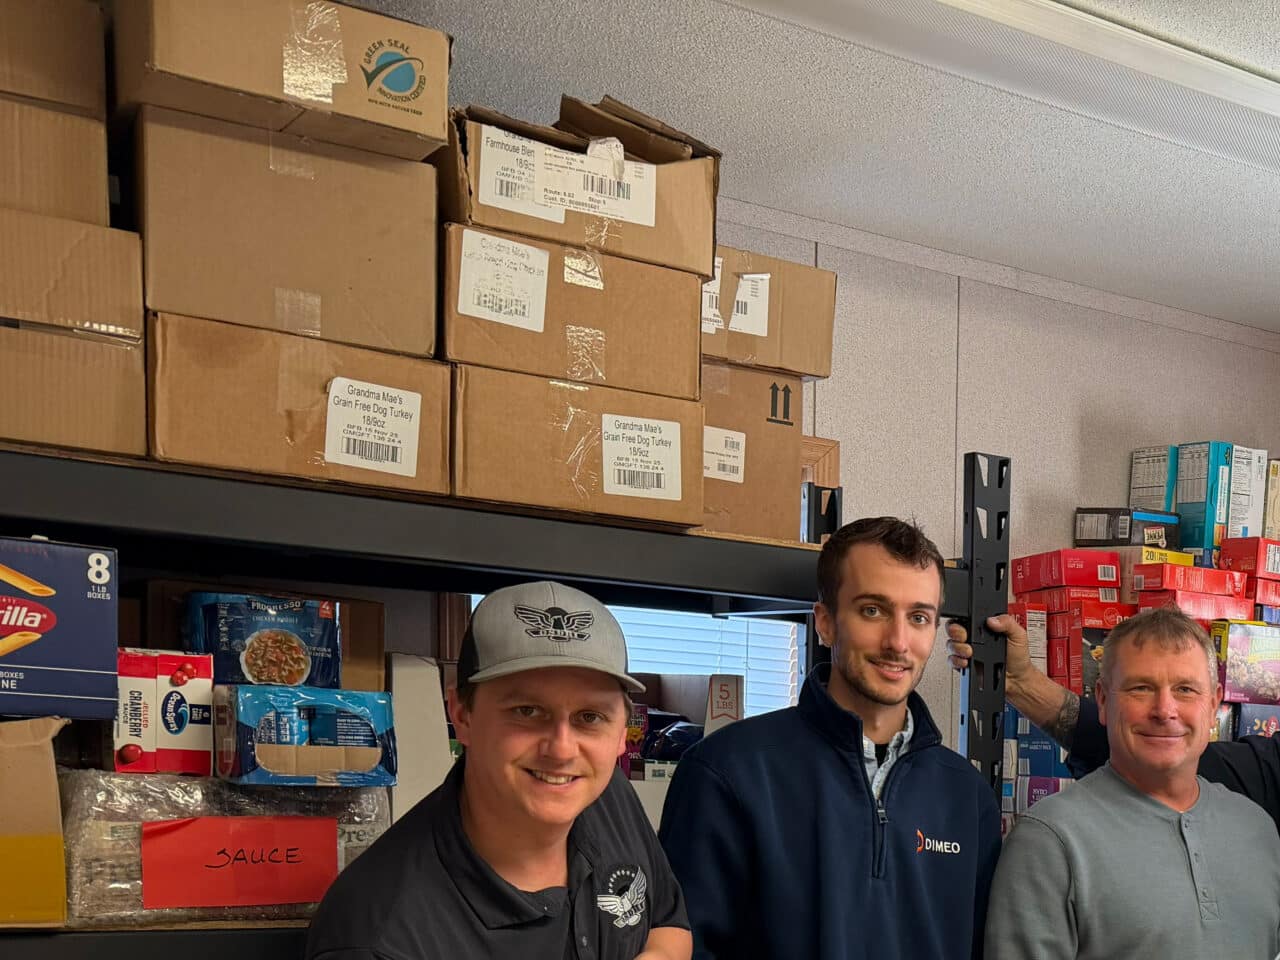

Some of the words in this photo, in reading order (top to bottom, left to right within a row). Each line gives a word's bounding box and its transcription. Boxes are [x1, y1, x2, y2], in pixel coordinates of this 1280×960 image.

[363, 40, 385, 64] GREEN
[387, 38, 411, 55] SEAL
[486, 136, 520, 155] Farmhouse
[521, 146, 535, 158] Blen
[347, 384, 380, 400] Grandma
[382, 391, 403, 405] Mae's
[333, 395, 353, 409] Grain
[354, 399, 372, 412] Free
[372, 403, 388, 418] Dog
[389, 406, 414, 422] Turkey
[362, 415, 386, 428] 18/9oz
[614, 419, 643, 432] Grandma
[644, 423, 662, 434] Mae's
[603, 431, 620, 441] Grain
[621, 433, 636, 444] Free
[637, 434, 650, 447] Dog
[651, 436, 672, 449] Turkey
[629, 446, 649, 458] 18/9oz
[87, 553, 111, 585] 8
[87, 591, 111, 600] BOXES
[251, 600, 301, 611] PROGRESSO
[1, 680, 17, 689] NE
[719, 684, 730, 700] 5
[166, 692, 181, 712] Ocean
[716, 701, 734, 710] LBS
[129, 690, 142, 738] CRANBERRY
[164, 712, 179, 731] Spray
[925, 838, 961, 854] DIMEO
